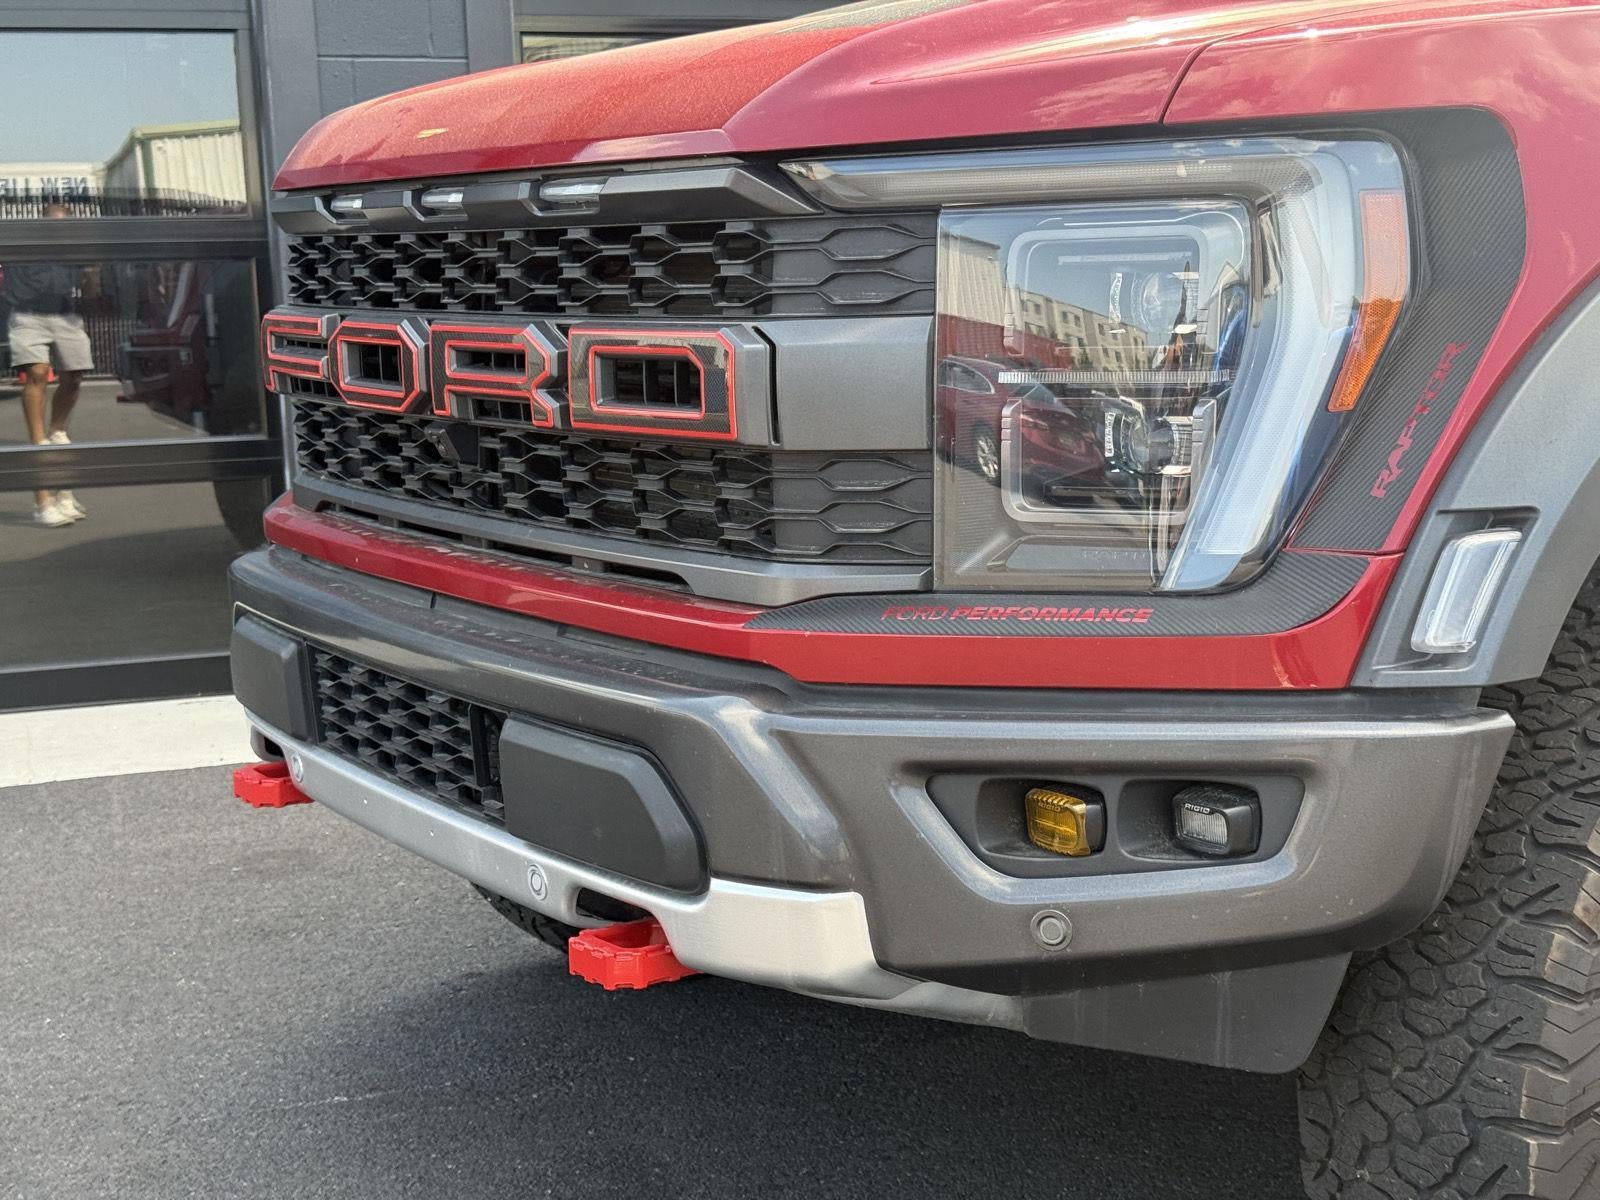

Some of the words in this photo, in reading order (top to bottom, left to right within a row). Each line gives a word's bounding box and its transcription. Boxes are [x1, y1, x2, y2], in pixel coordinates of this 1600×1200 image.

[261, 313, 738, 440] FORD
[1370, 340, 1472, 498] RAPTOR
[881, 605, 949, 621] FORD
[950, 605, 1154, 623] PERFORMANCE
[1184, 802, 1211, 814] RIGID
